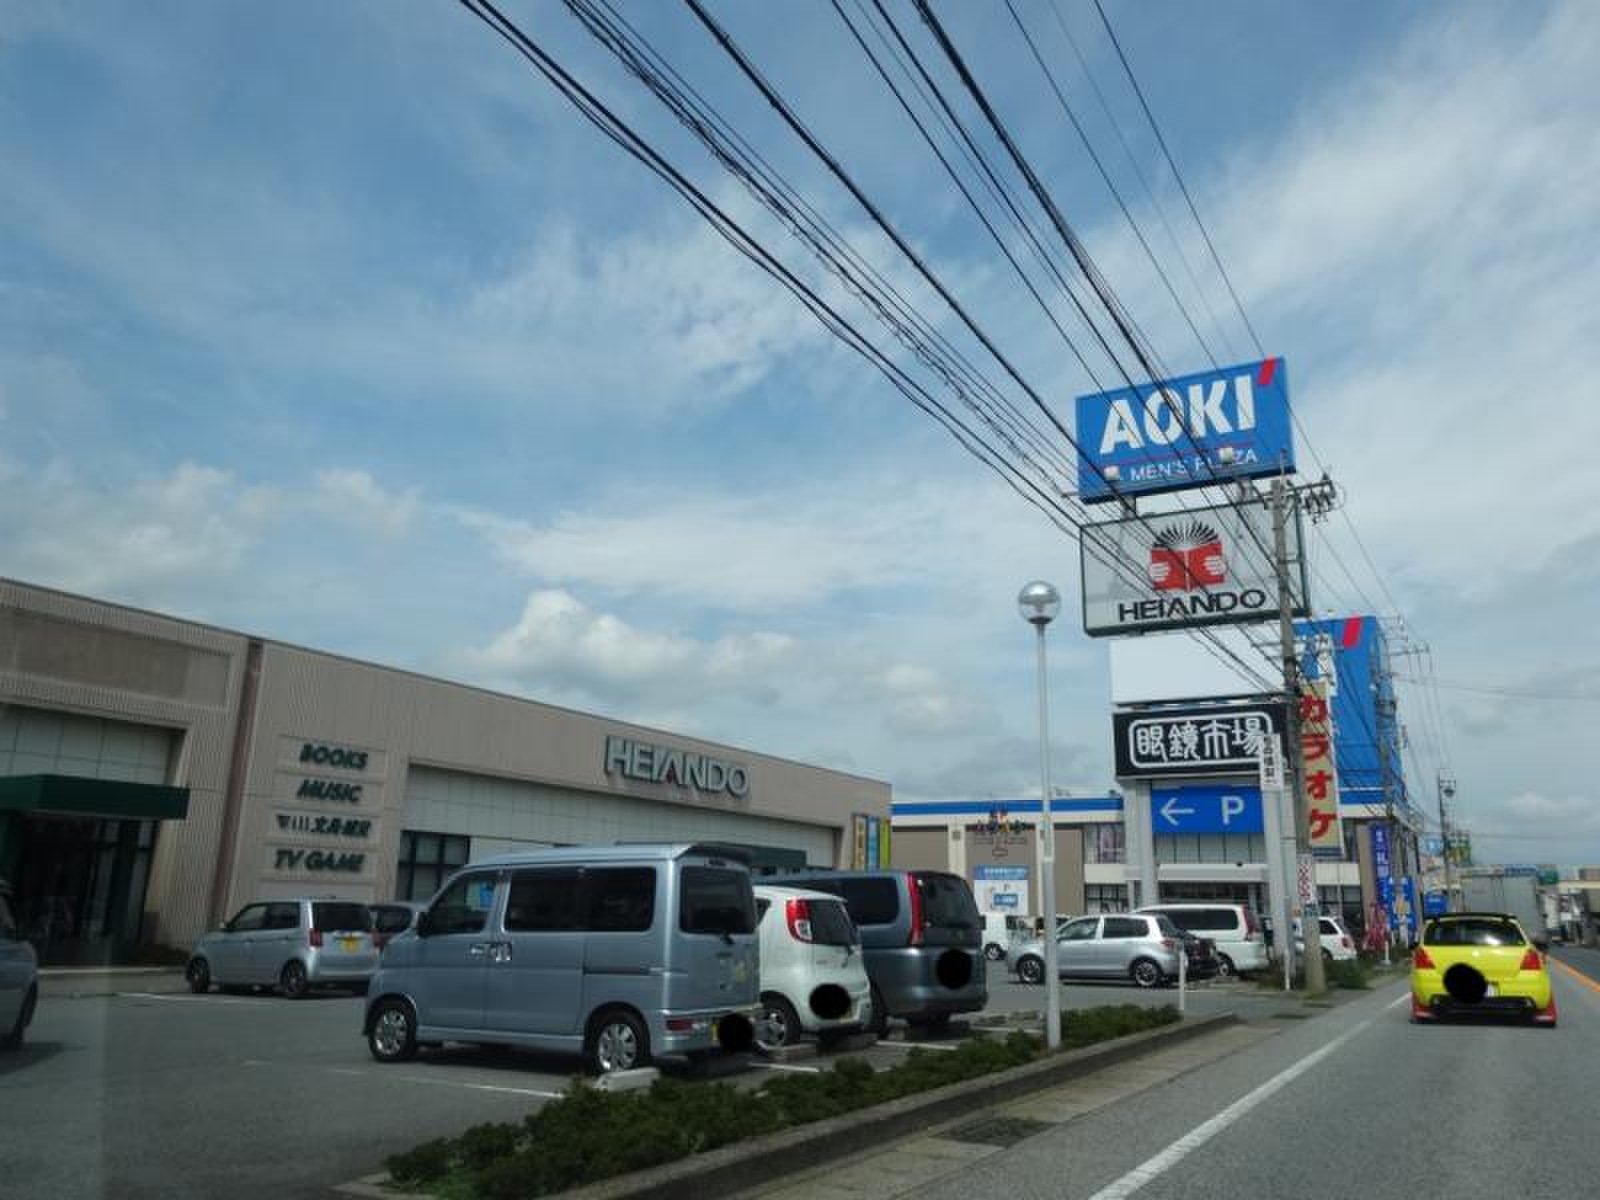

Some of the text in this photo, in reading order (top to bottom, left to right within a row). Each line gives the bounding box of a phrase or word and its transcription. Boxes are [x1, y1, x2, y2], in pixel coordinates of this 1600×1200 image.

[1100, 374, 1256, 455] AOKI
[1118, 589, 1267, 622] HEIANDO
[1135, 718, 1262, 763] 眼鏡市場
[299, 744, 369, 770] BOOKS
[605, 736, 750, 798] HEIANDO
[296, 779, 363, 803] MUSIC
[1221, 796, 1245, 825] P
[274, 849, 365, 873] TV GAME
